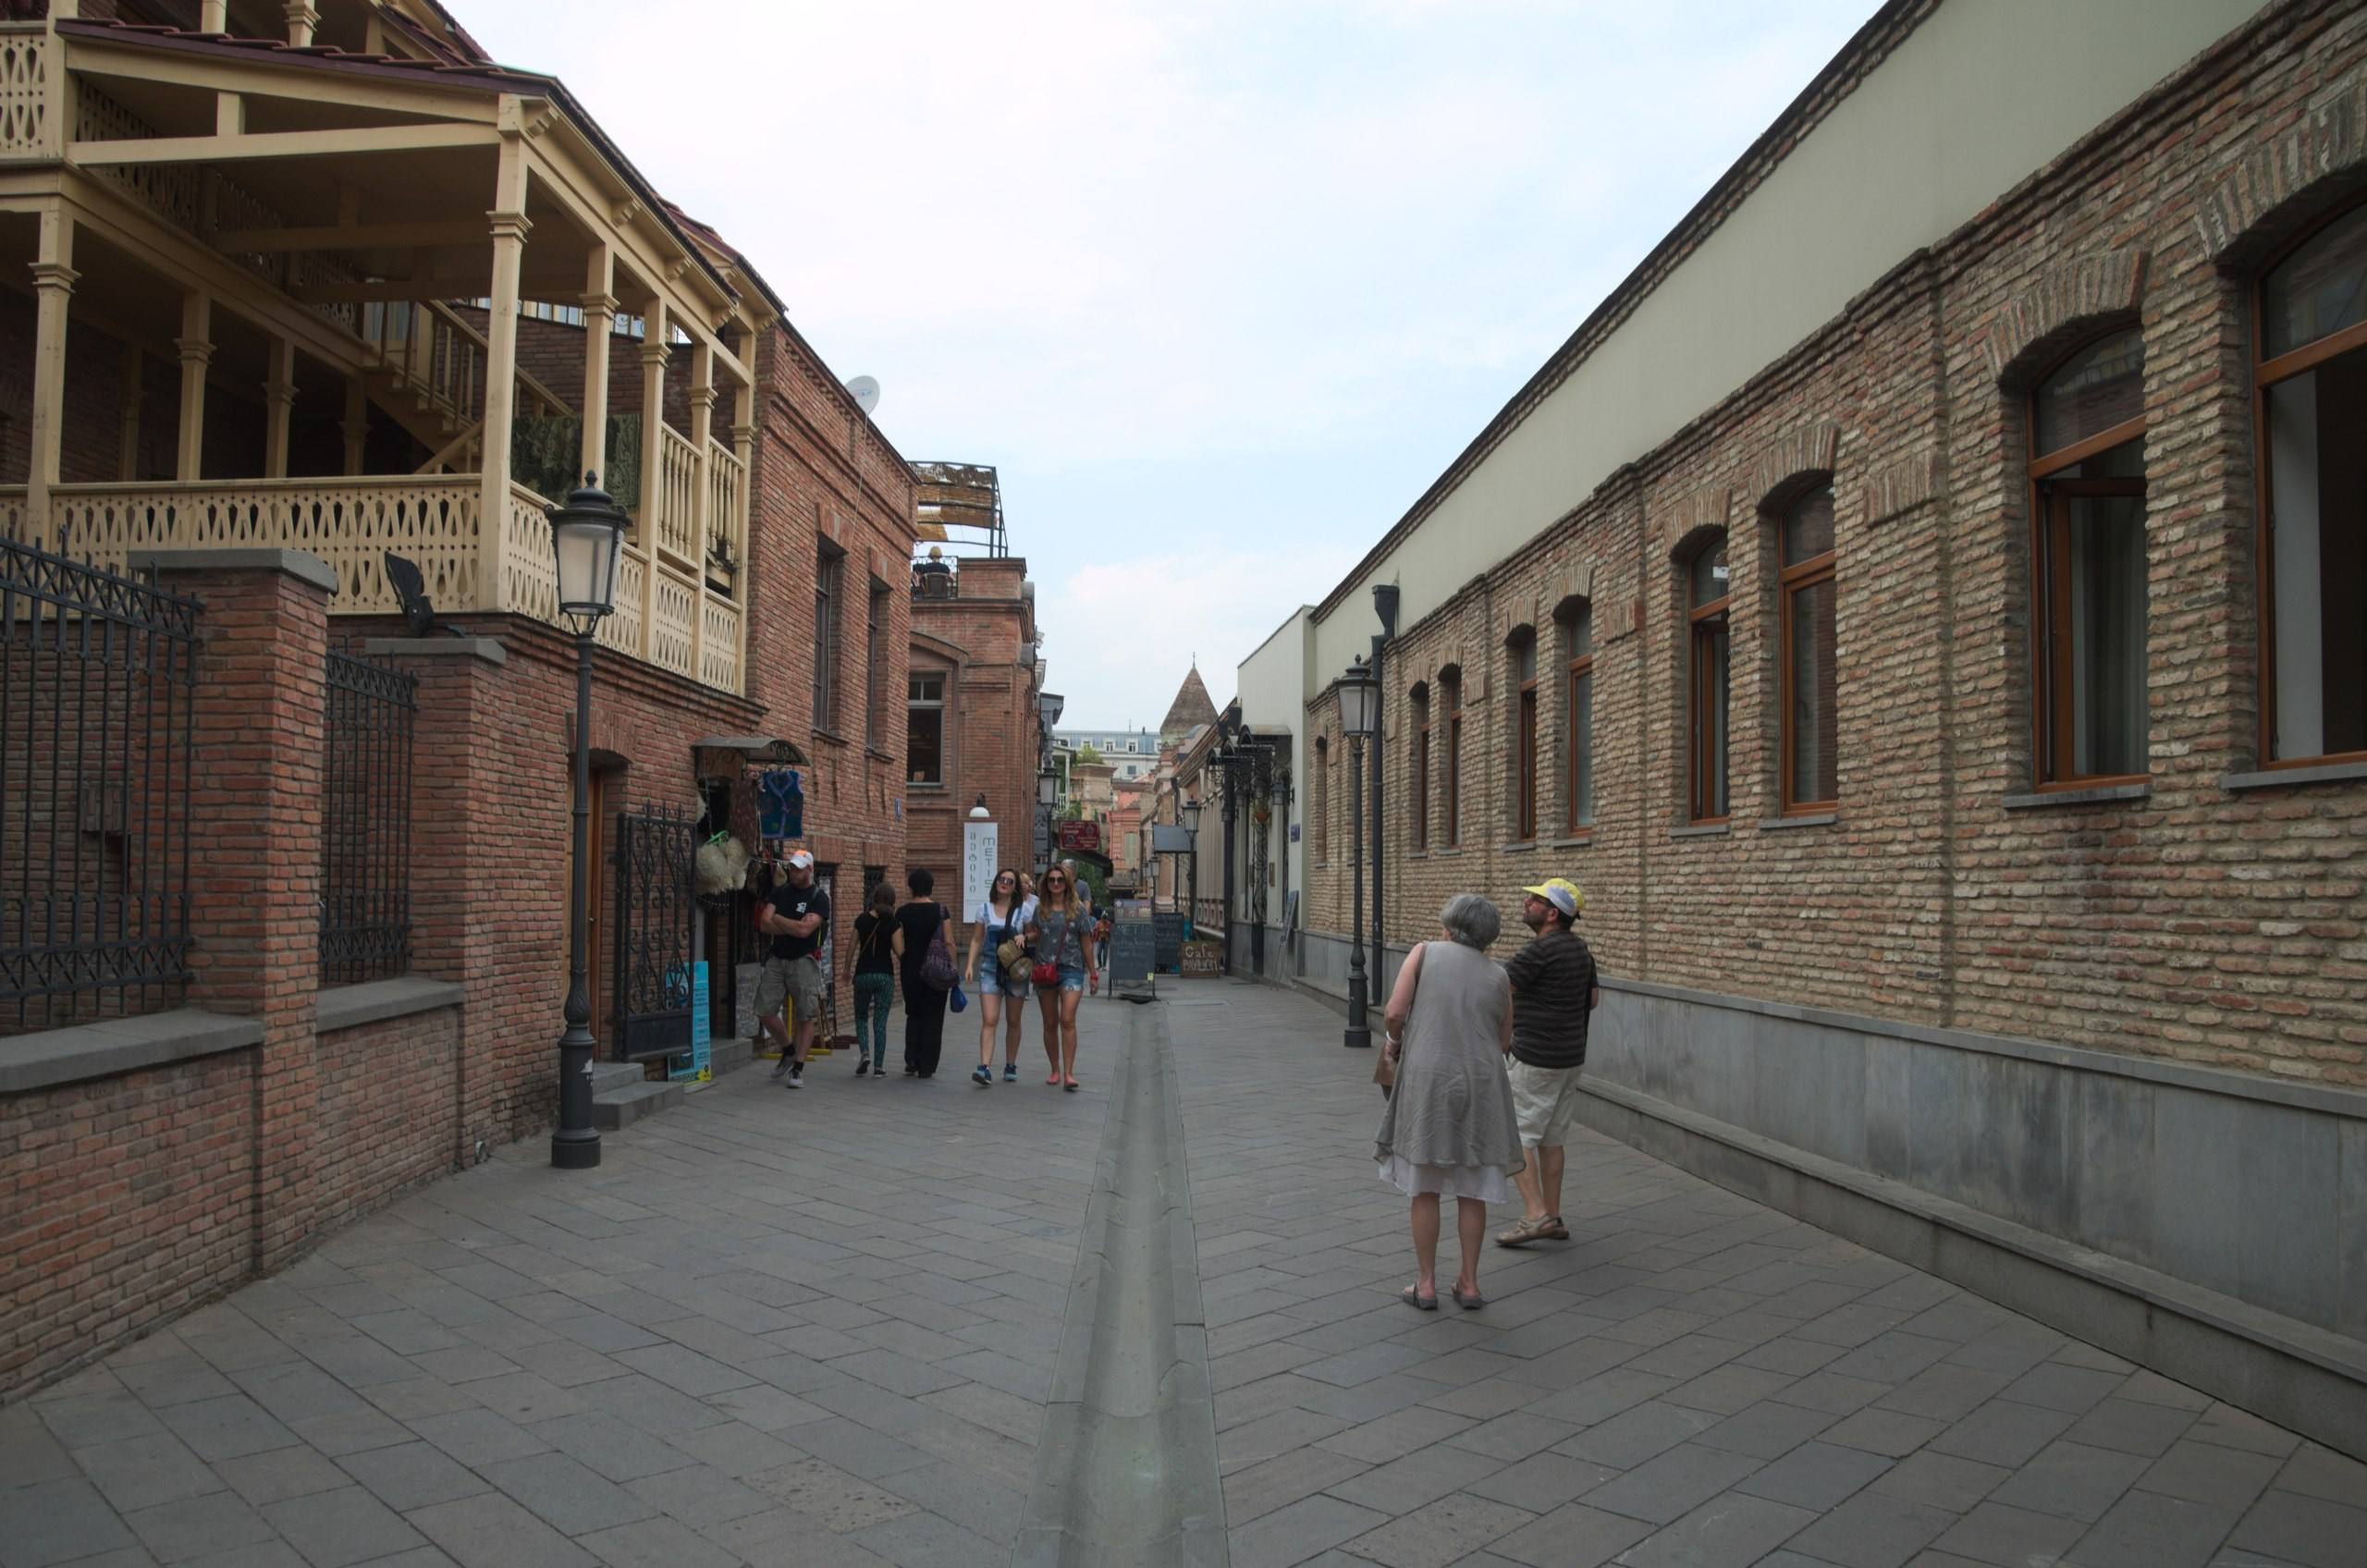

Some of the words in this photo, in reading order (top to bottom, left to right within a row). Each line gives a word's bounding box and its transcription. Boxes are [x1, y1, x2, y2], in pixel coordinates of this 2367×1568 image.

[983, 837, 995, 888] METIS
[1116, 925, 1153, 936] METIS
[1185, 943, 1214, 958] Cafe
[1184, 959, 1218, 972] PAVILION
